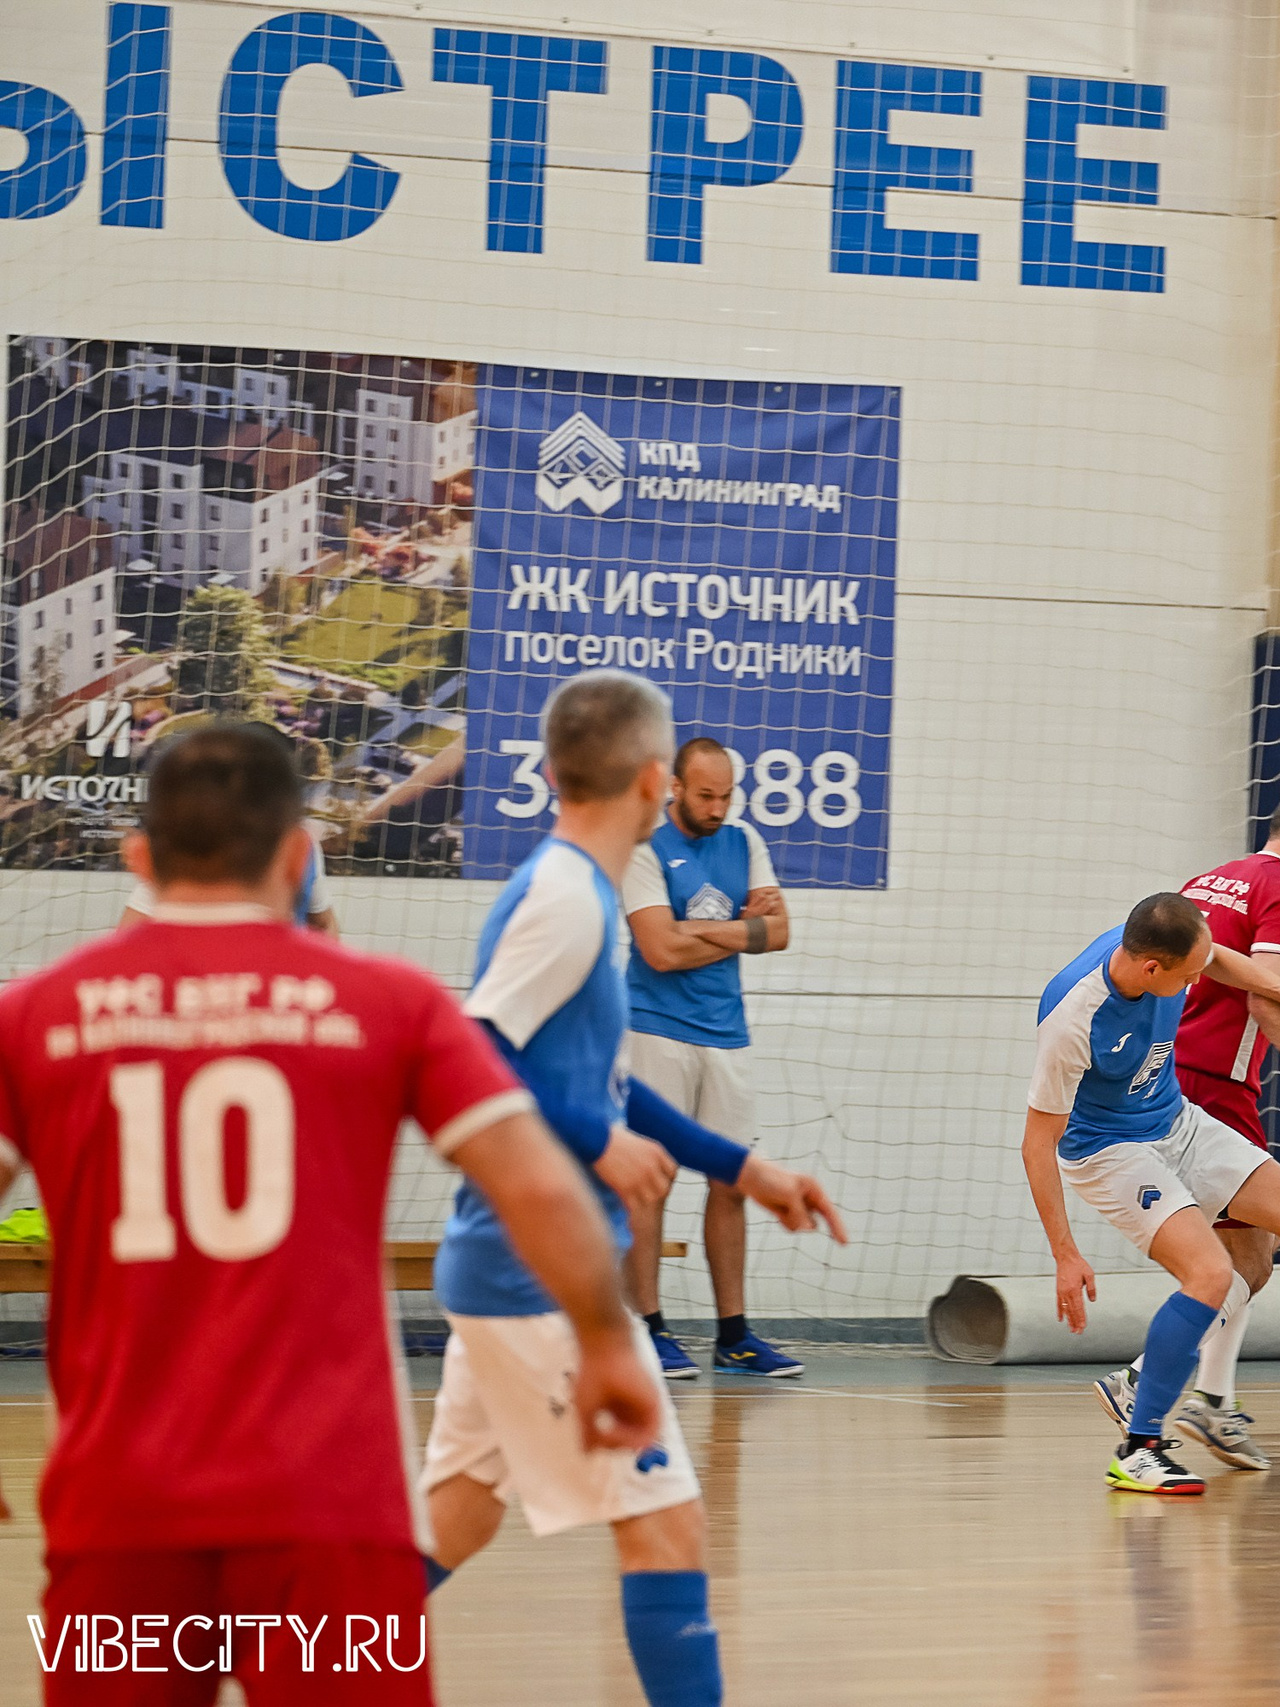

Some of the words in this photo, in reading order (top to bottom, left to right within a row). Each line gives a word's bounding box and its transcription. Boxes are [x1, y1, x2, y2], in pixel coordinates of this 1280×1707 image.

[638, 441, 701, 473] КПД
[637, 475, 842, 514] КАЛИНИНГРАД
[506, 564, 593, 614] ЖК
[602, 568, 861, 626] ИСТОЧНИК
[504, 630, 676, 669] поселок
[685, 627, 862, 680] Родники
[108, 1053, 297, 1266] 10
